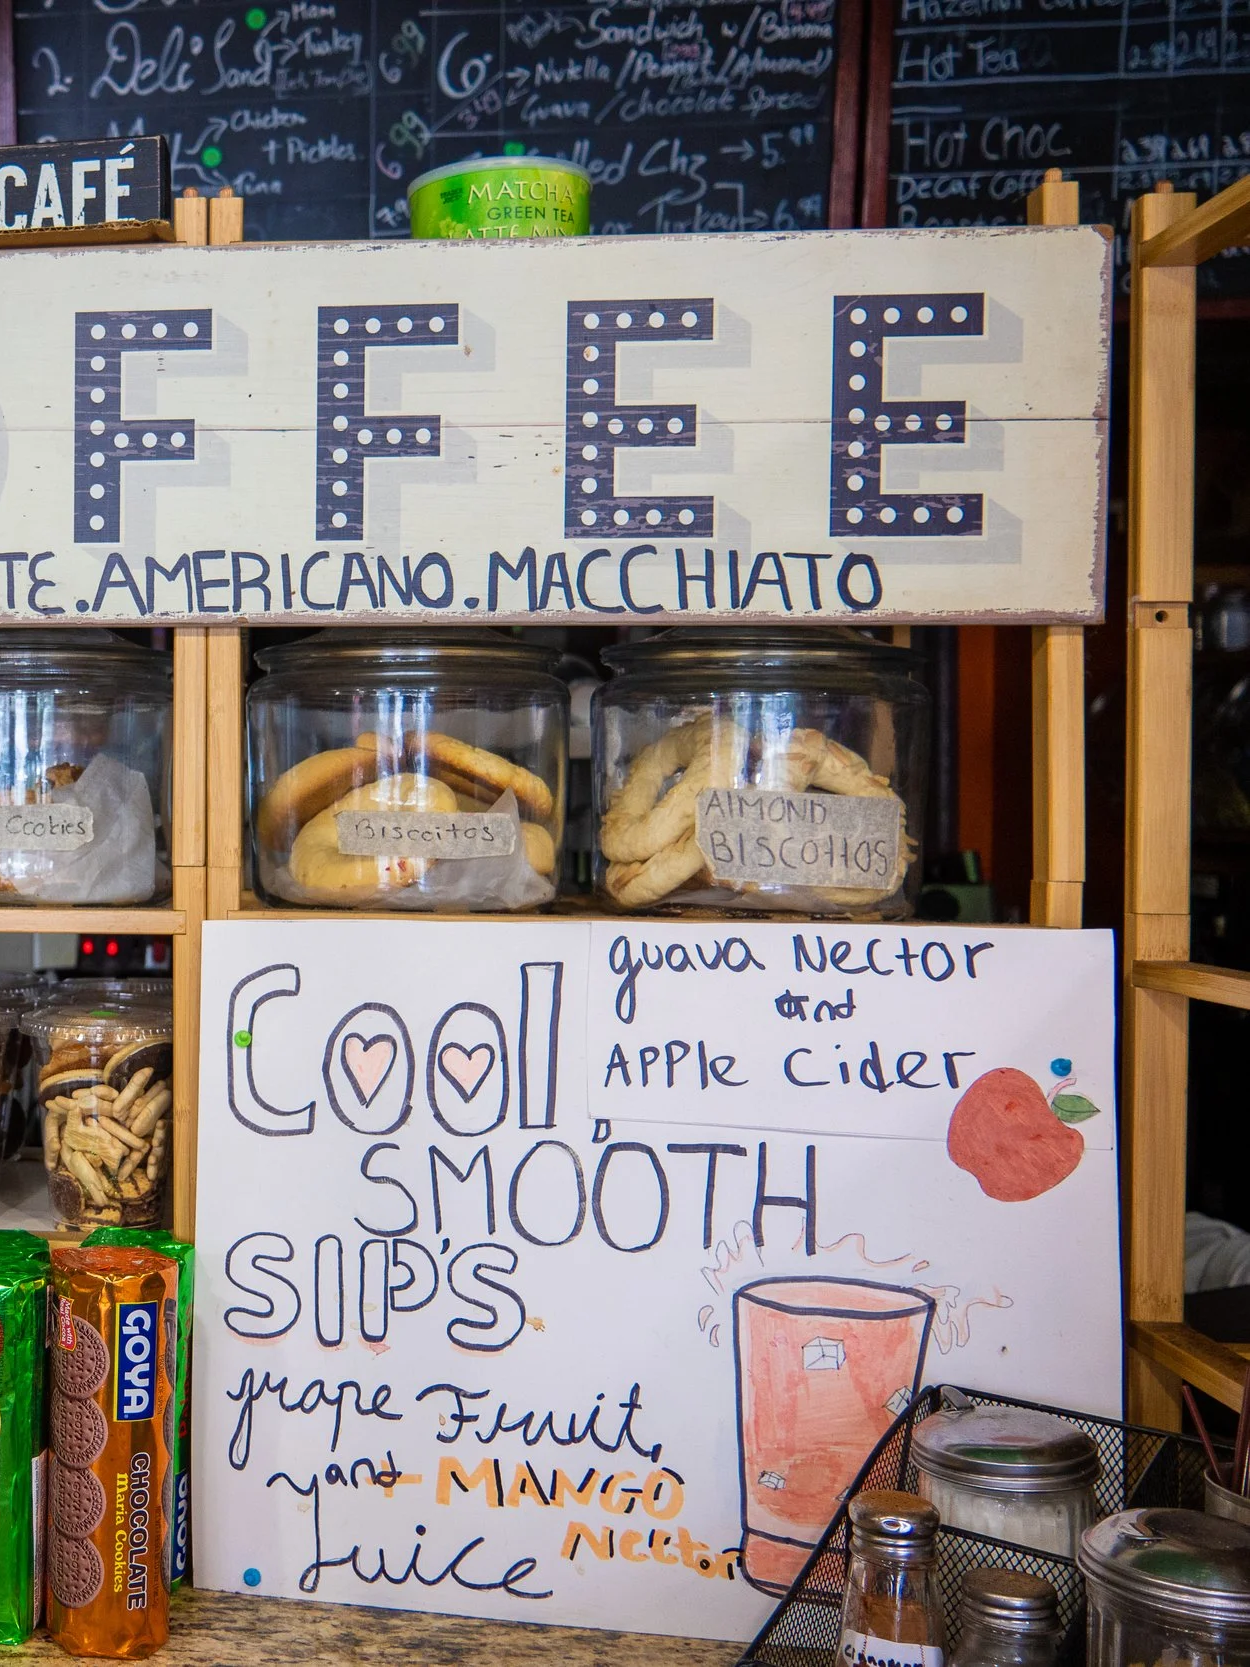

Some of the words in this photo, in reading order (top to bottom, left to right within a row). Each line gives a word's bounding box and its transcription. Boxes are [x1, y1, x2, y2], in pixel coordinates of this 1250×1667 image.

[90, 20, 204, 98] Deli
[898, 40, 962, 82] Hot
[967, 36, 1021, 75] Tea
[902, 116, 967, 172] Hot
[467, 181, 575, 206] MATCHA
[487, 206, 546, 221] GREEN
[552, 208, 575, 224] TEA
[464, 224, 520, 239] ATTE
[487, 545, 883, 615] MACCHIATO
[607, 936, 764, 1024] guava
[353, 1141, 818, 1257] SMOOTH
[122, 1309, 151, 1414] GOYA
[435, 1456, 686, 1520] MANGO
[114, 1530, 127, 1593] Cookies
[127, 1452, 150, 1610] CHOCOLATE
